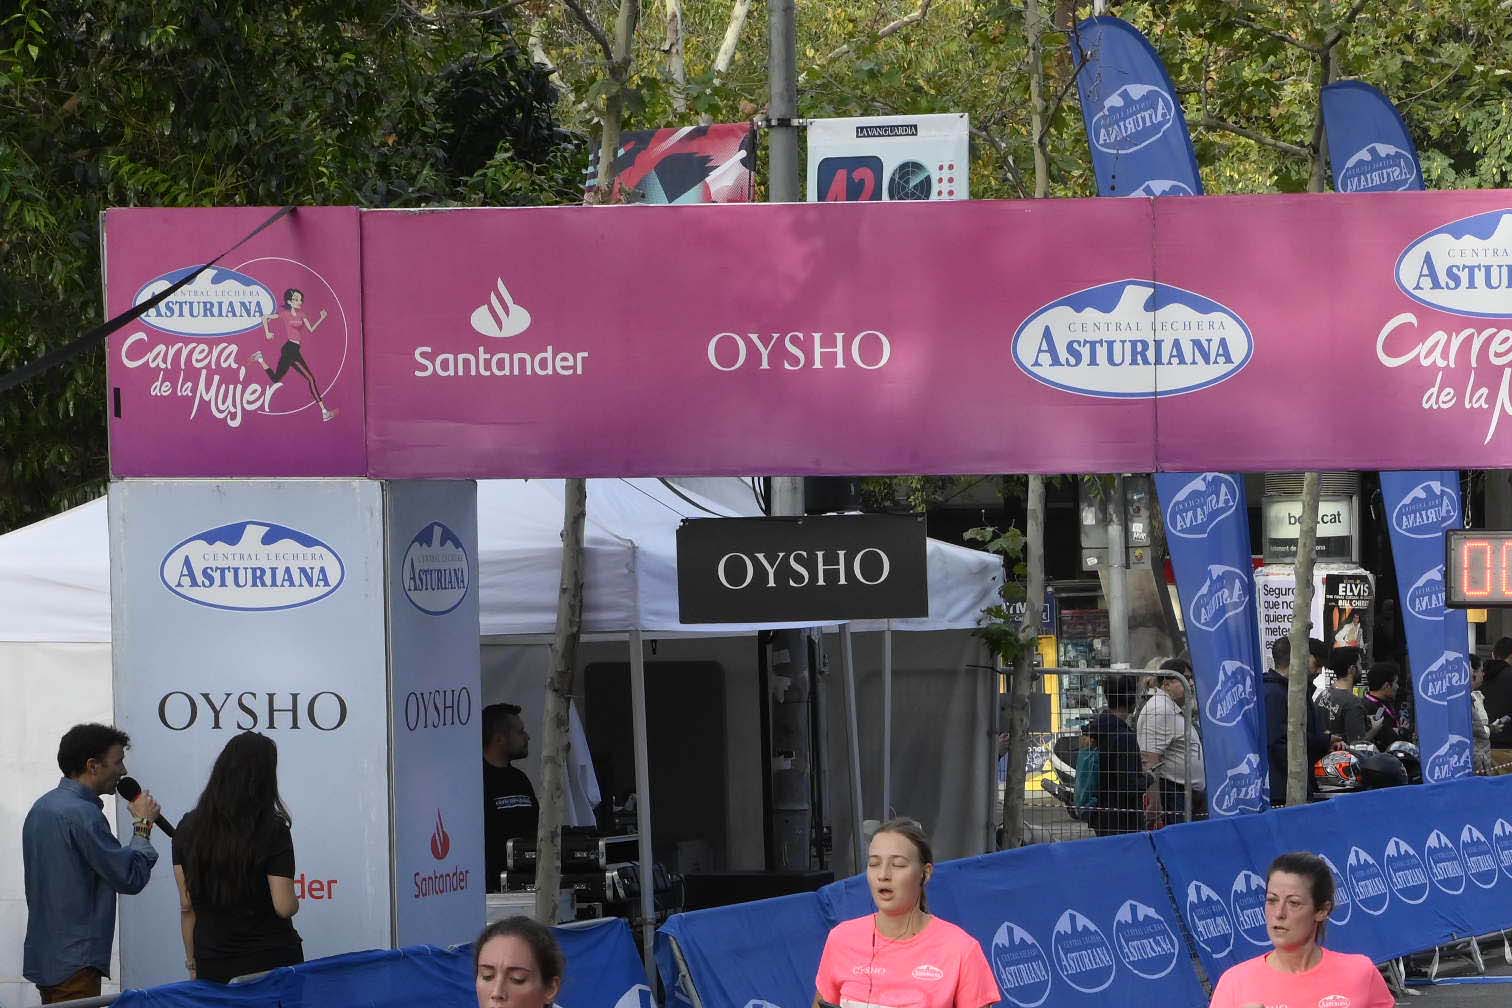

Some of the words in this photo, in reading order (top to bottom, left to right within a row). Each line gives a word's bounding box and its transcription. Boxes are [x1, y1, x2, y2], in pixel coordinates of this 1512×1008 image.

[172, 289, 211, 298] ENTRAL
[1067, 321, 1143, 333] CENTRAL
[1151, 319, 1227, 332] LECHERA
[121, 331, 239, 370] Carrera
[414, 345, 589, 377] Santander
[707, 330, 892, 372] OYSHO
[1030, 324, 1235, 369] ASTURIANA
[150, 371, 173, 397] de
[177, 370, 193, 397] la
[190, 366, 284, 428] Mujer
[1421, 371, 1456, 410] de
[1464, 372, 1489, 410] la
[175, 554, 332, 589] ASTURIANA
[202, 552, 261, 562] CENTRAL
[267, 551, 325, 562] LECHERA
[407, 556, 466, 592] ASTURIANA
[717, 546, 891, 591] OYSHO
[1338, 583, 1369, 597] ELVIS
[1263, 602, 1280, 615] que
[157, 690, 348, 732] OYSHO
[405, 686, 471, 732] OYSHO
[413, 866, 470, 901] Santander
[997, 955, 1048, 990] ASTURIANA
[1058, 943, 1113, 976] ASTURIANA
